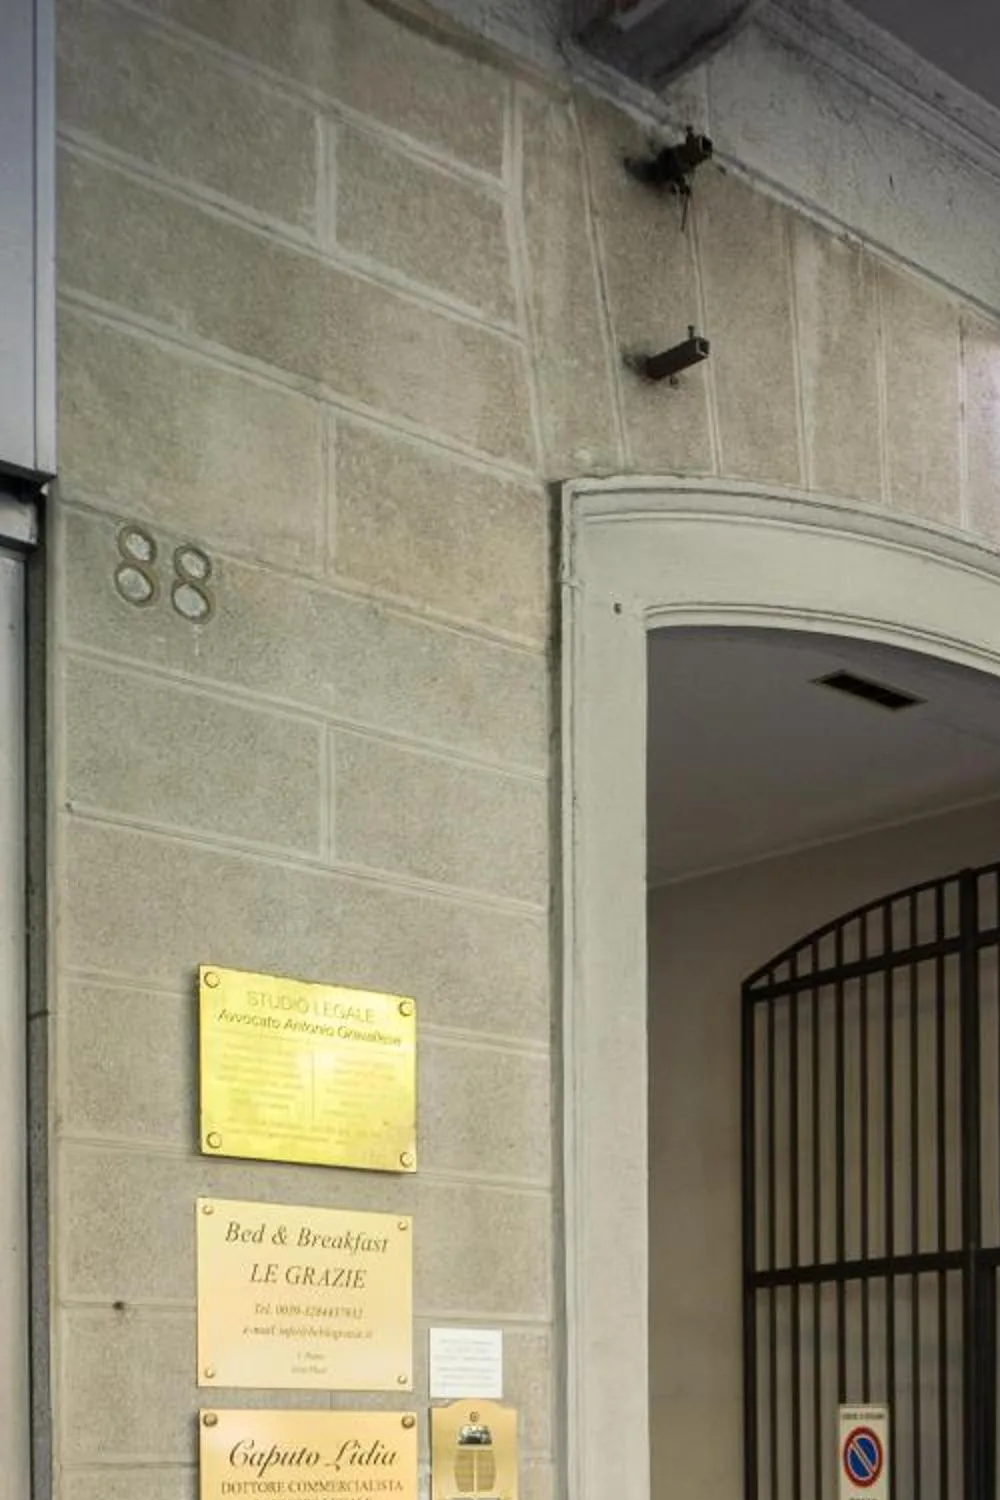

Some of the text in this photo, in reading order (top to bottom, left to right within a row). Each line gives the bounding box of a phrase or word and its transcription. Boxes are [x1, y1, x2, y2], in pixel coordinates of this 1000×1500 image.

[114, 525, 215, 625] 88
[218, 1009, 281, 1028] Avvocato
[284, 1018, 335, 1037] Antonio
[247, 990, 376, 1024] STUDIO LEGALE
[225, 1220, 388, 1255] Bed & Breakfast
[249, 1263, 368, 1289] LE GRAZIE
[229, 1438, 398, 1478] Caputo Lidia
[221, 1479, 404, 1495] DOTTORE COMMERCIALISTA
